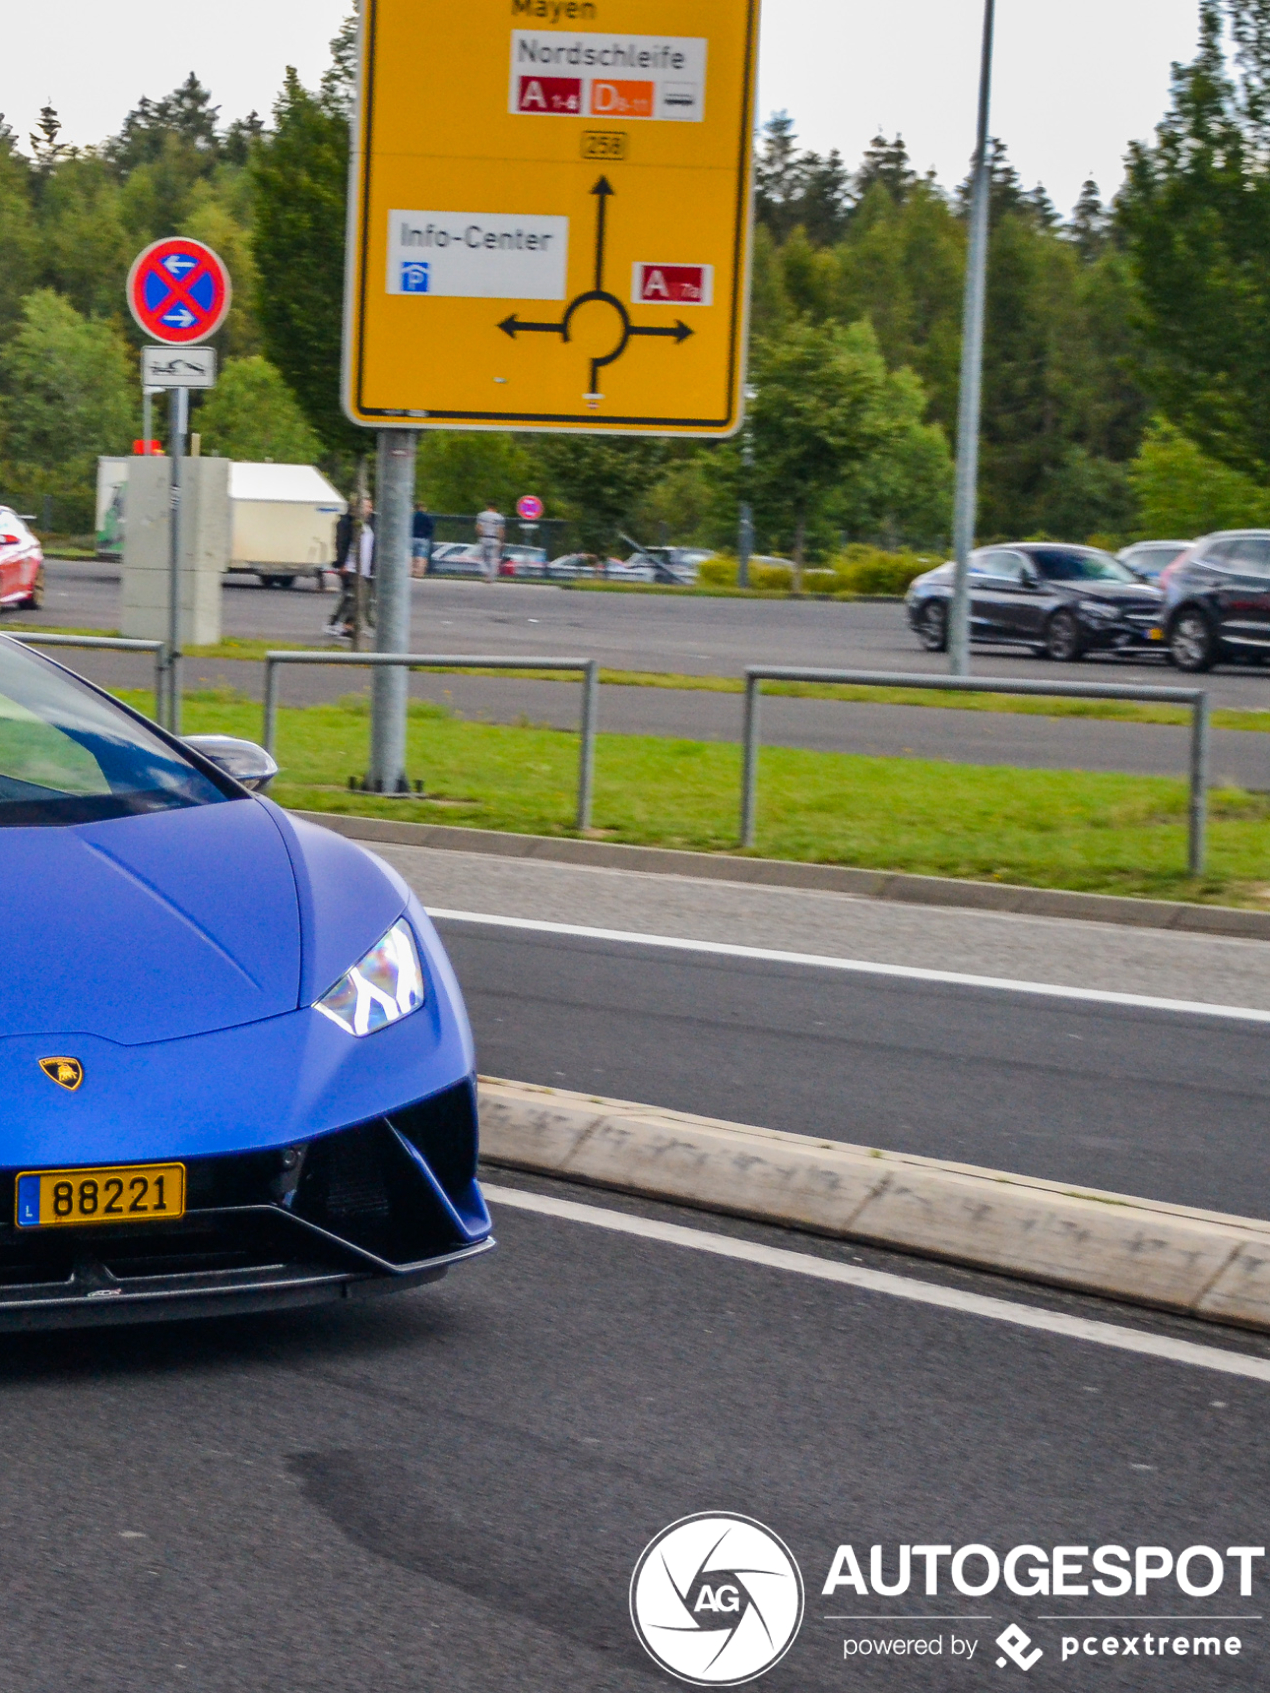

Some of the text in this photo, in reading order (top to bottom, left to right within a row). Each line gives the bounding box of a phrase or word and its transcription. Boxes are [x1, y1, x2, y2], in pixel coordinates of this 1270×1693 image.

[512, 0, 597, 23] Mayen
[518, 39, 685, 69] Nordschleife
[401, 222, 554, 251] Info-Center
[407, 271, 425, 290] P
[53, 1175, 167, 1216] 88221
